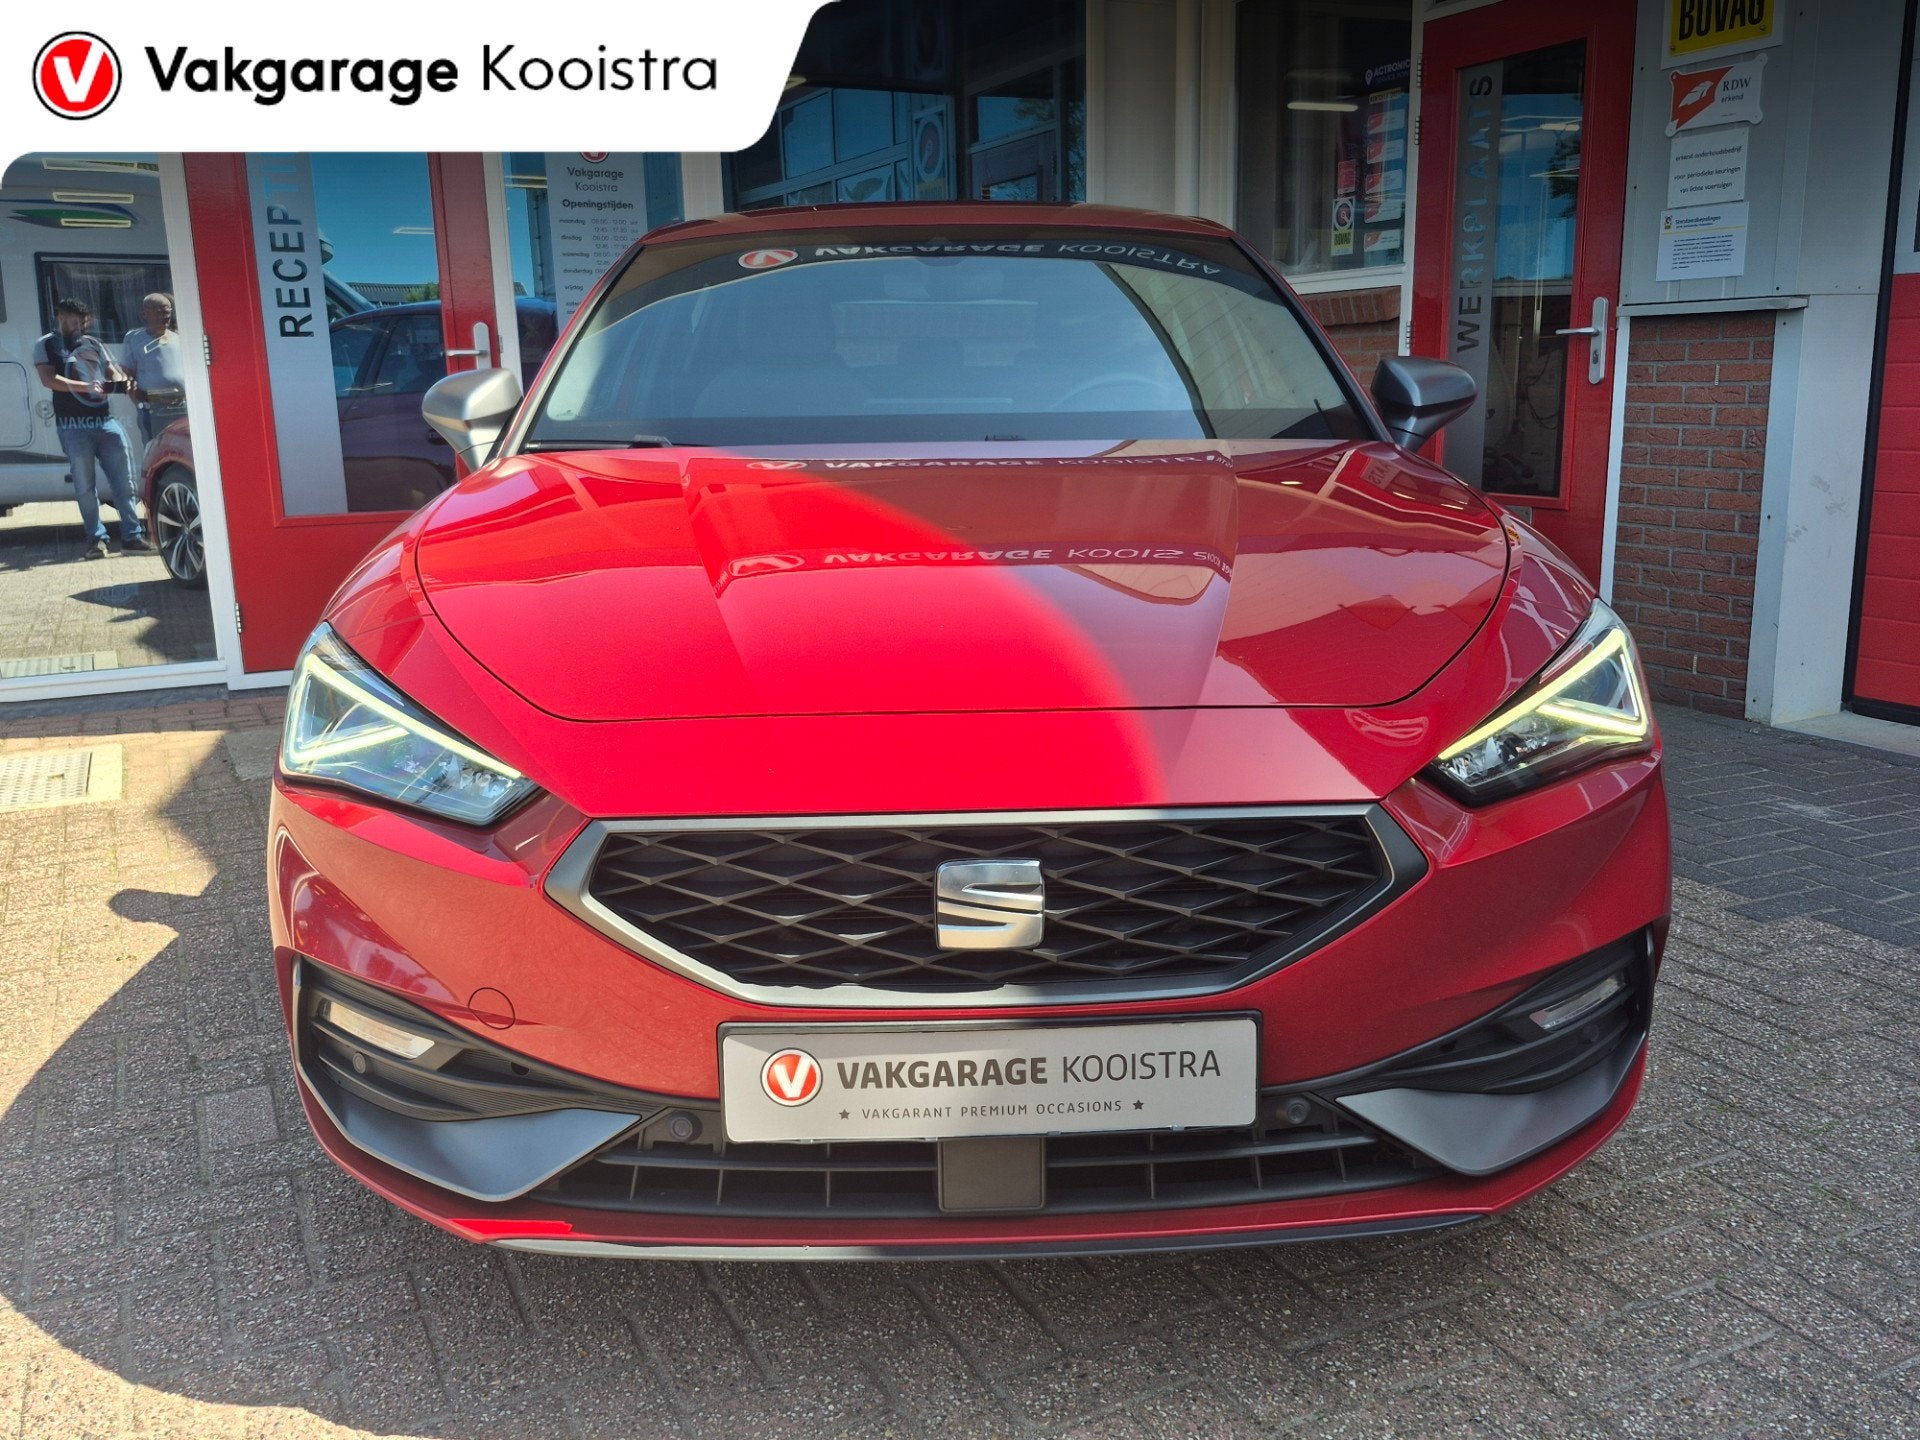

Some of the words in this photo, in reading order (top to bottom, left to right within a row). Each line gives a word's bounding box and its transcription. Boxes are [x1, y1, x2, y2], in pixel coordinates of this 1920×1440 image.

[1722, 75, 1752, 92] RDW
[1721, 94, 1744, 103] erkend
[566, 166, 624, 180] Vakgarage
[575, 181, 619, 193] Kooistra
[561, 198, 634, 211] Openingstijden
[1457, 75, 1493, 352] WERKPLAATS
[836, 1056, 1048, 1090] VAKGARAGE
[1062, 1049, 1221, 1084] KOOISTRA
[862, 1106, 951, 1120] VAKGARANT
[961, 1104, 1028, 1118] PREMIUM
[1036, 1100, 1122, 1115] OCCASIONS
